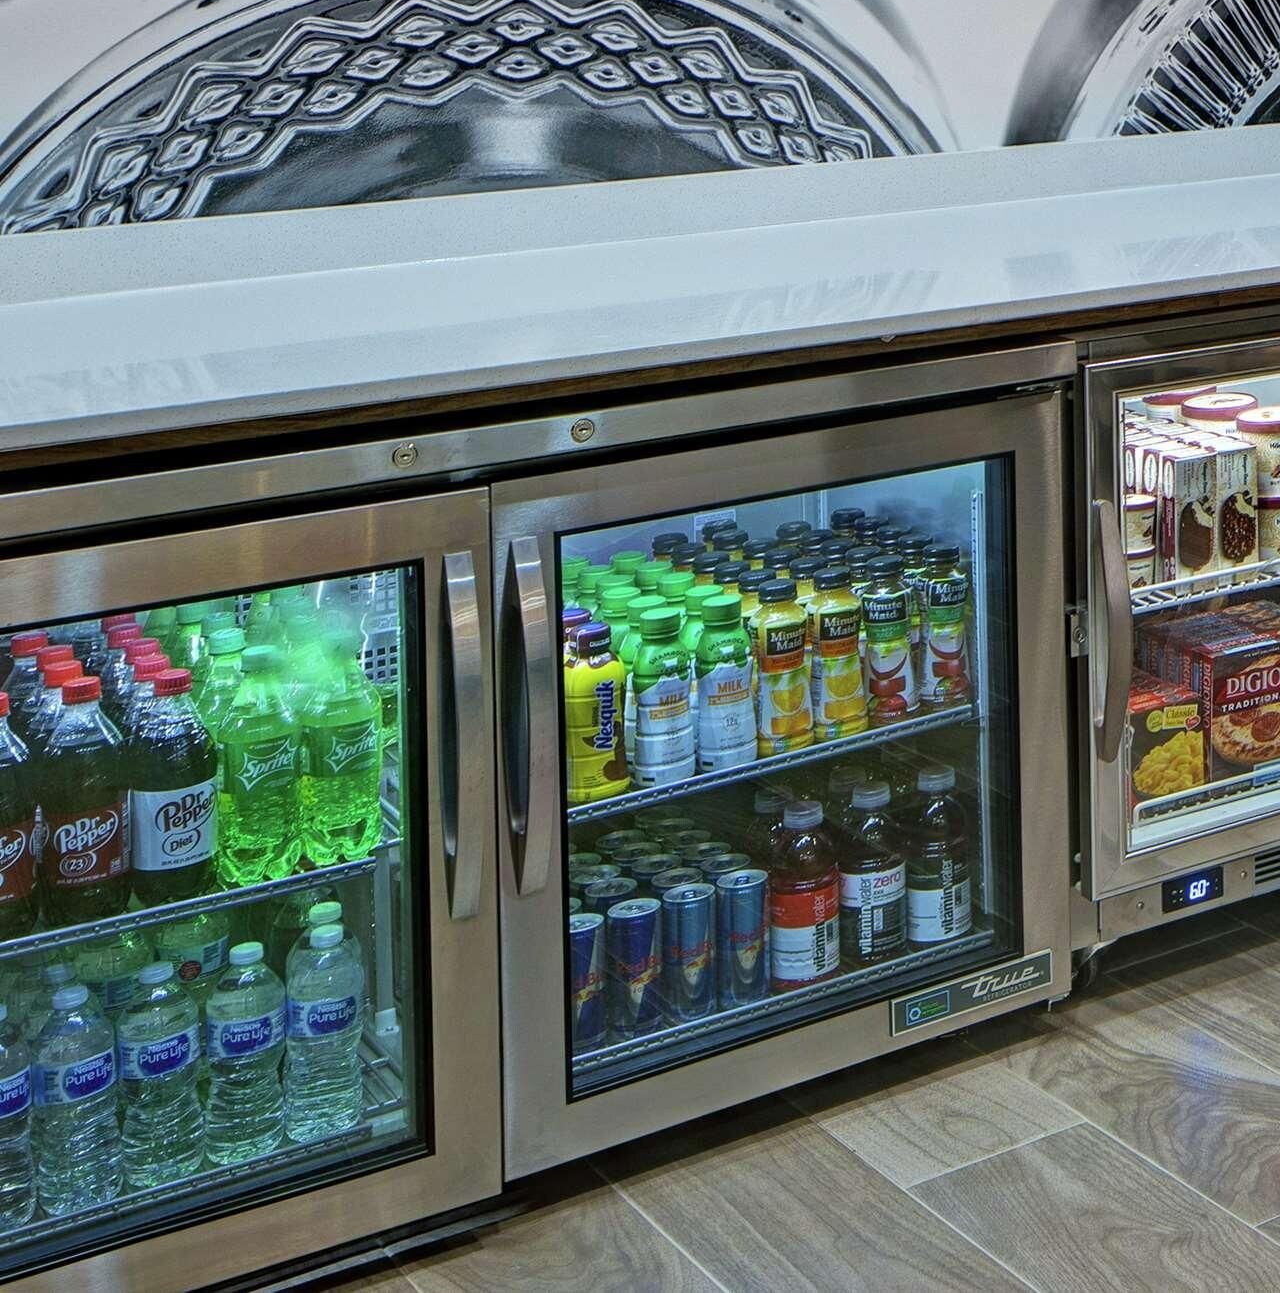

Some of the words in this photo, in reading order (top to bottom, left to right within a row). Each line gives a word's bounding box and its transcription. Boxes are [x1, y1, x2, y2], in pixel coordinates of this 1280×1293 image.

[863, 600, 903, 612] Minute
[868, 609, 898, 621] Maid
[829, 625, 857, 638] Maid
[776, 639, 803, 652] Maid
[716, 679, 743, 693] MILK
[595, 680, 615, 751] Nesquik
[248, 751, 294, 777] Sprite
[169, 834, 194, 851] Diet
[873, 870, 901, 889] zero
[858, 877, 873, 956] vitaminwater
[309, 1010, 337, 1024] Pure
[222, 1030, 251, 1044] Pure
[140, 1049, 163, 1066] Pure
[164, 1042, 189, 1059] Life
[65, 1066, 93, 1087] Pure
